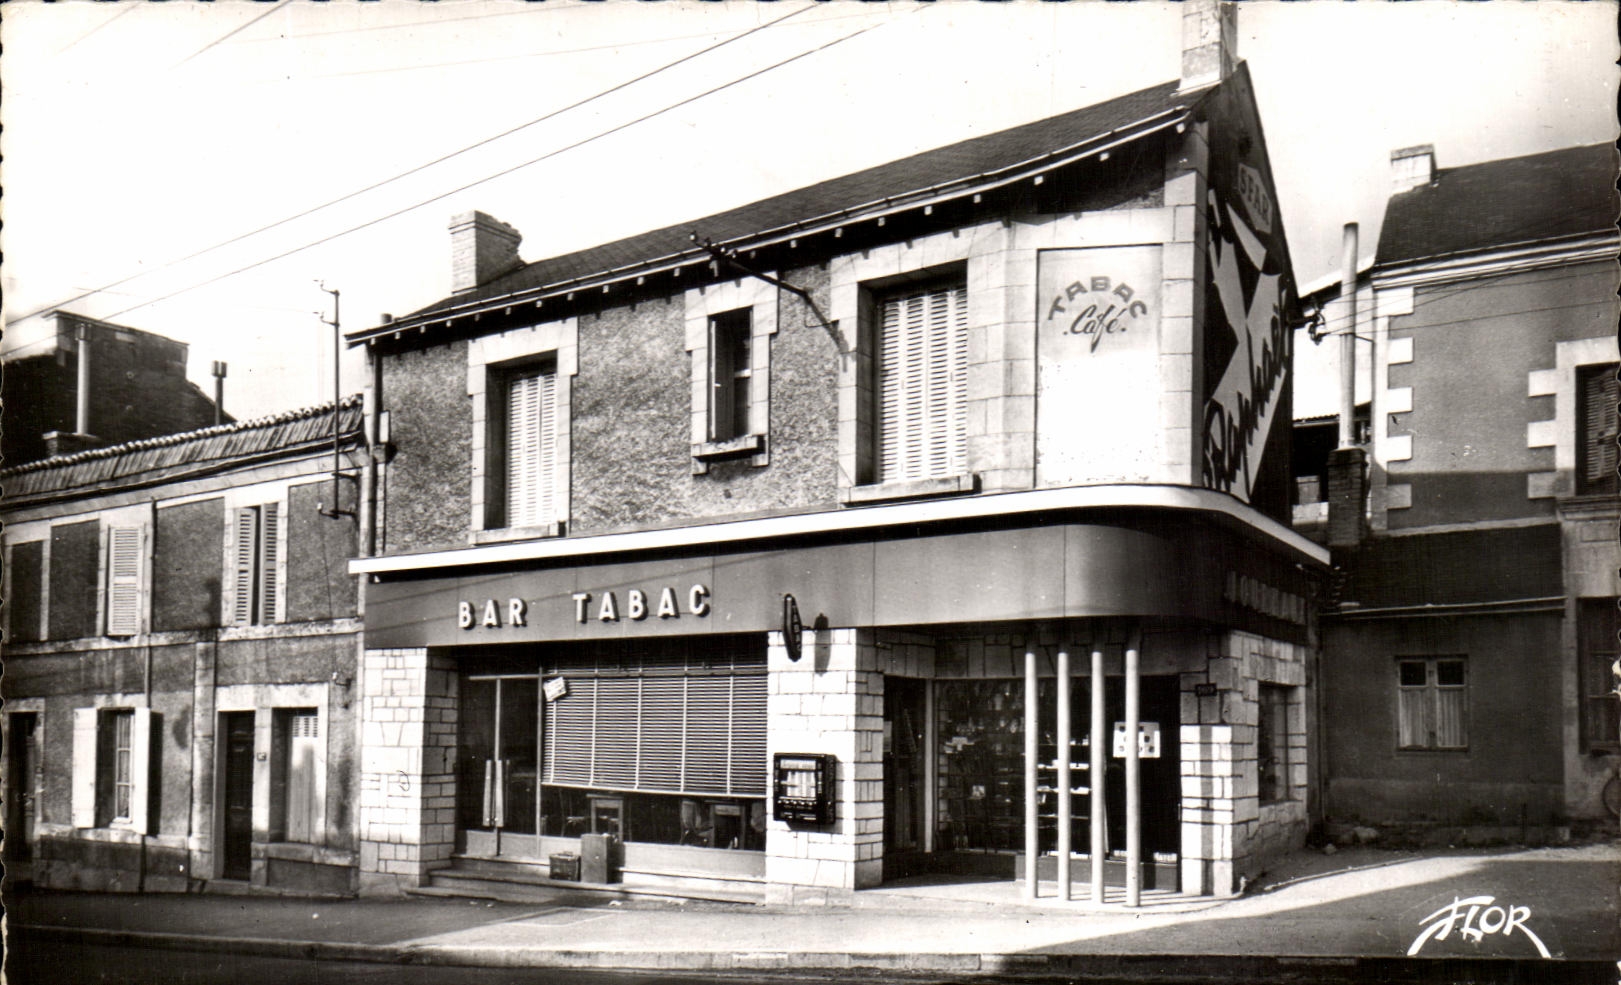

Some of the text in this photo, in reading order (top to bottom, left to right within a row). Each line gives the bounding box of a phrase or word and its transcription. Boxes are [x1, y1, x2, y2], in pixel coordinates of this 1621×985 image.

[1047, 275, 1148, 321] TABAC
[458, 584, 713, 629] BAR TABAC
